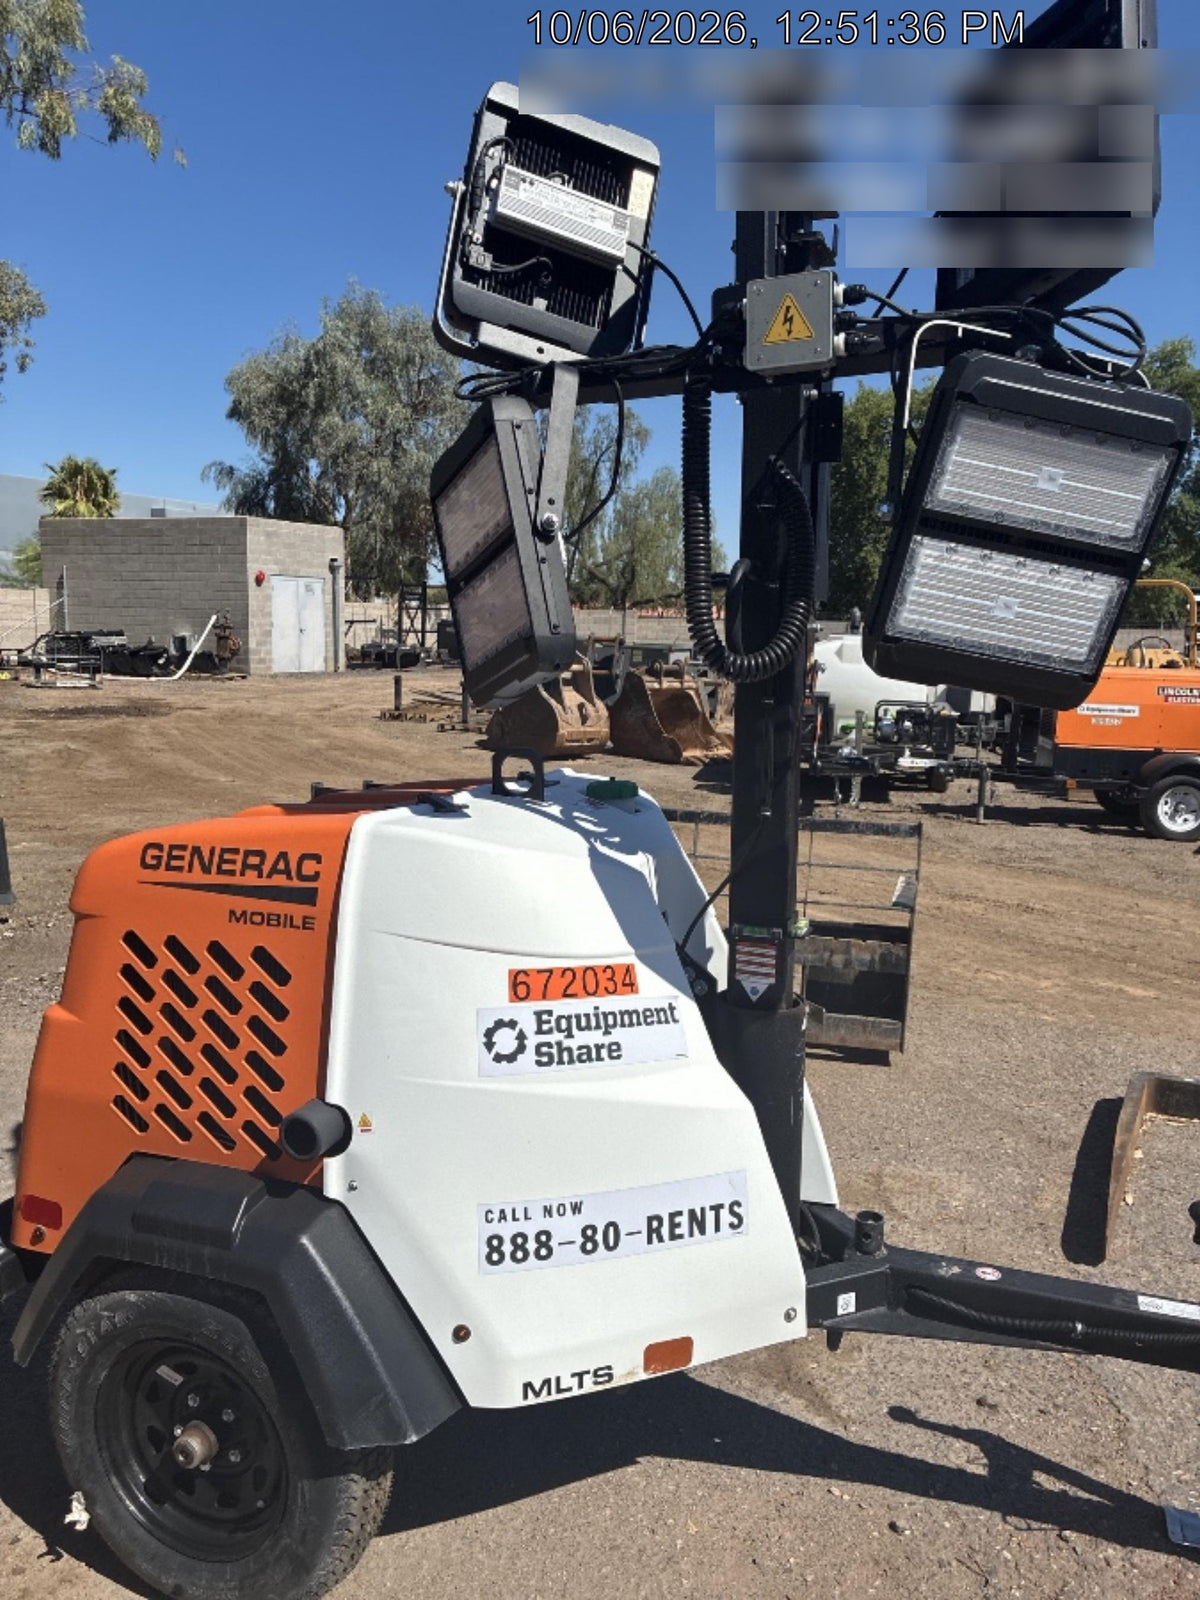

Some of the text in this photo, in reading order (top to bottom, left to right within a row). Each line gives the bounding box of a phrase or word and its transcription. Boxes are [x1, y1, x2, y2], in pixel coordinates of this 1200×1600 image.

[139, 842, 323, 882] GENERAC
[228, 909, 317, 931] MOBILE
[511, 964, 636, 1001] 672034
[533, 1002, 680, 1039] Equipment
[534, 1040, 623, 1067] Share
[484, 1200, 584, 1224] CALL NOW
[484, 1199, 745, 1266] 888-80-RENTS
[522, 1364, 615, 1401] MLTS
